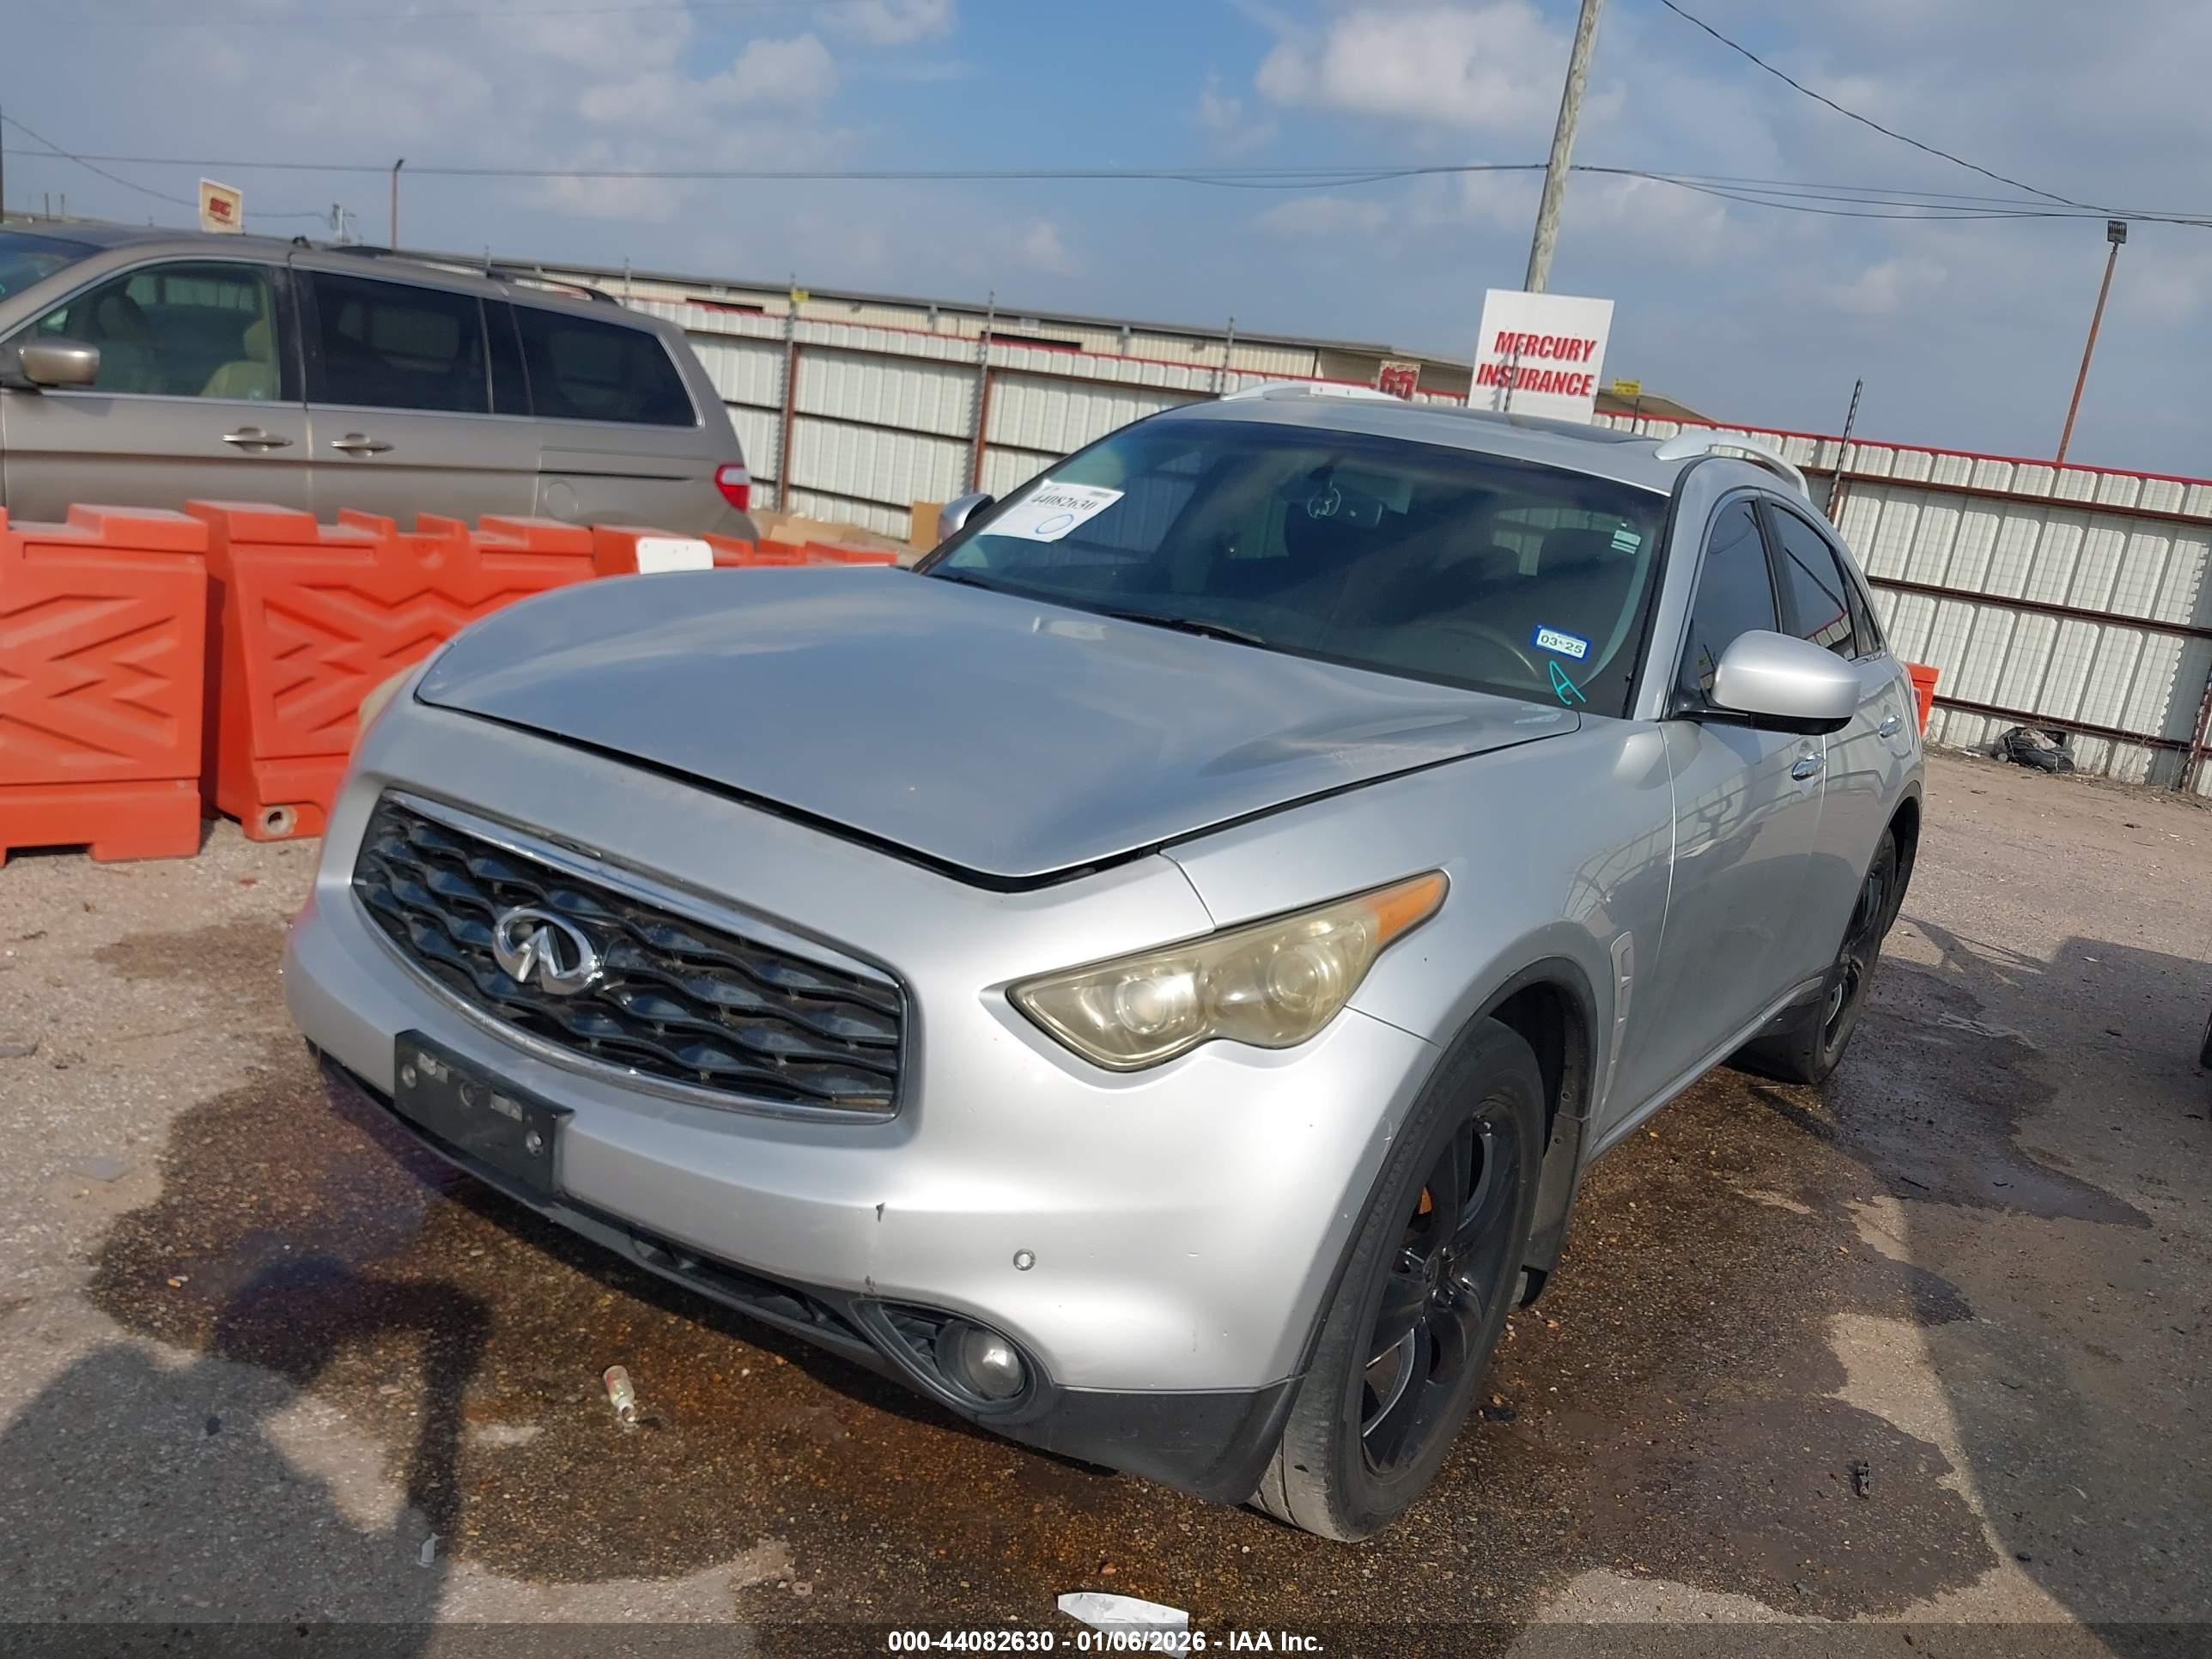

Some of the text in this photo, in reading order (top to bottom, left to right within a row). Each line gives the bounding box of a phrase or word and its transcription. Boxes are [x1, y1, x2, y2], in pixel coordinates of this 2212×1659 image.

[1493, 331, 1598, 362] MERCURY
[1476, 363, 1595, 398] INSURANCE
[1540, 635, 1583, 653] 03 25
